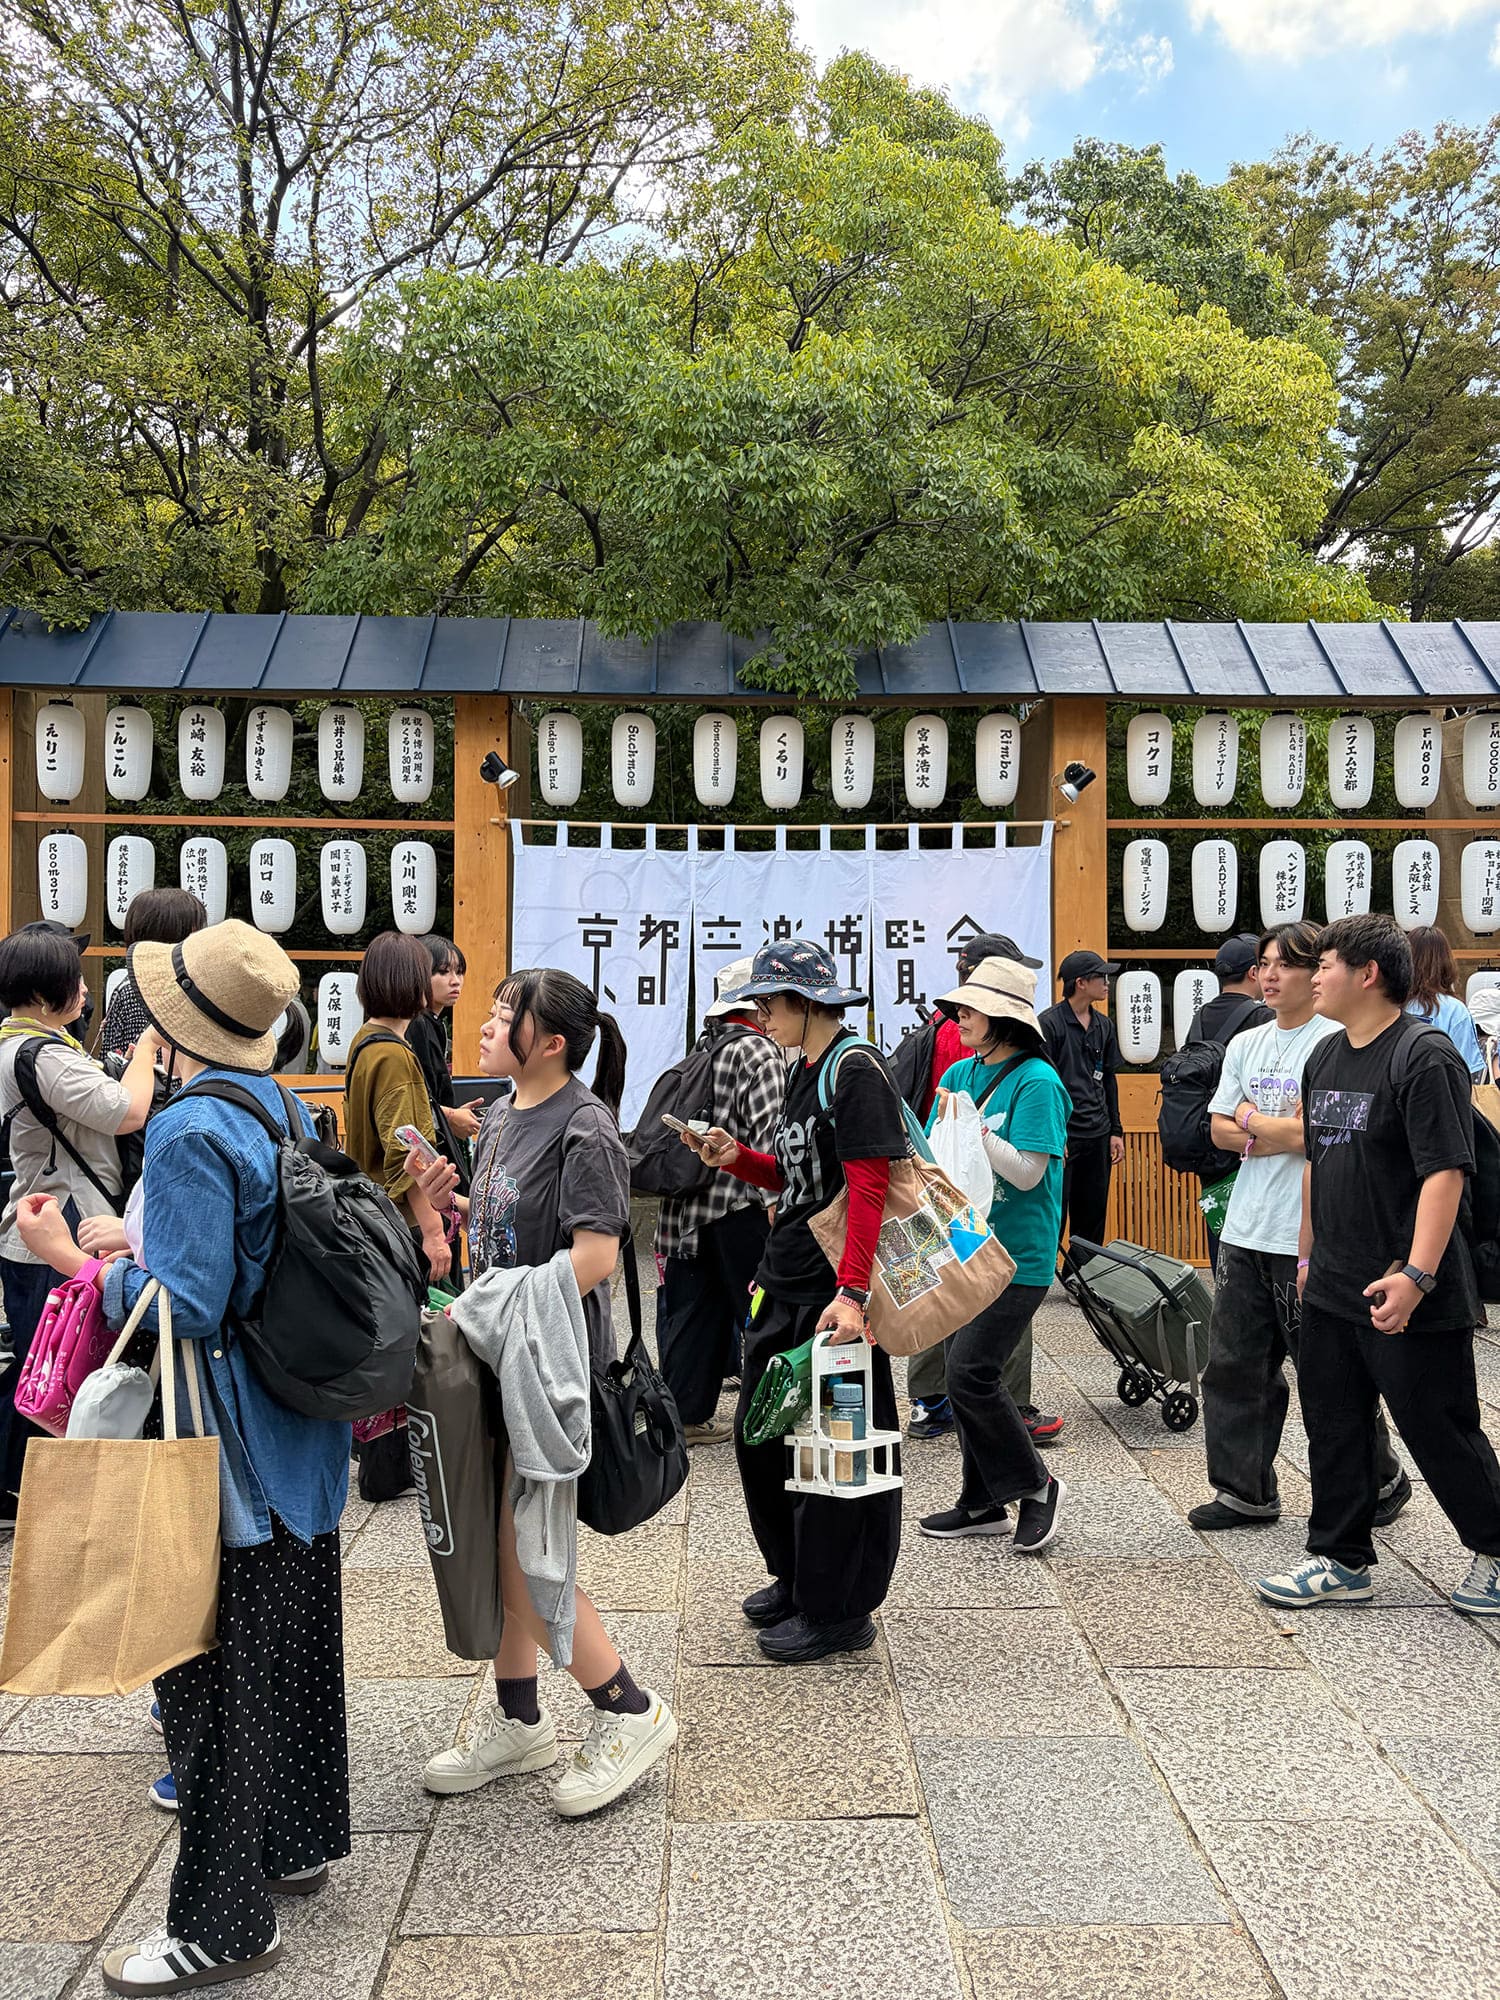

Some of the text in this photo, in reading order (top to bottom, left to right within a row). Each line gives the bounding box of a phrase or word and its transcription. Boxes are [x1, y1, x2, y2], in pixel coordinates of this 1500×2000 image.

[46, 723, 59, 771] えりこ
[113, 716, 127, 778] こんこん
[547, 719, 559, 791] indigo la End
[627, 724, 639, 786] Suchmos
[712, 720, 723, 788] Homecomings
[776, 732, 788, 781] くるり
[844, 721, 855, 792] マカロニえんぴつ
[916, 727, 931, 788] 宮本浩次
[999, 729, 1013, 780] Rimba
[1146, 731, 1161, 777] コクヨ
[1287, 723, 1297, 790] FLAG RADIO
[1344, 724, 1358, 791] エフエム京都
[1421, 727, 1432, 786] FM802
[1488, 721, 1500, 791] FM COCOLO
[1217, 847, 1227, 915] READYFOR
[1275, 870, 1287, 912] 株式会社
[1287, 852, 1298, 910] ペンタゴン
[1356, 851, 1365, 889] 株式会社
[1408, 861, 1422, 915] 大阪シミズ
[1421, 851, 1432, 892] 株式会社
[1130, 994, 1142, 1045] はれおとこ
[1142, 982, 1153, 1024] 有限会社
[406, 1414, 433, 1522] Coleman
